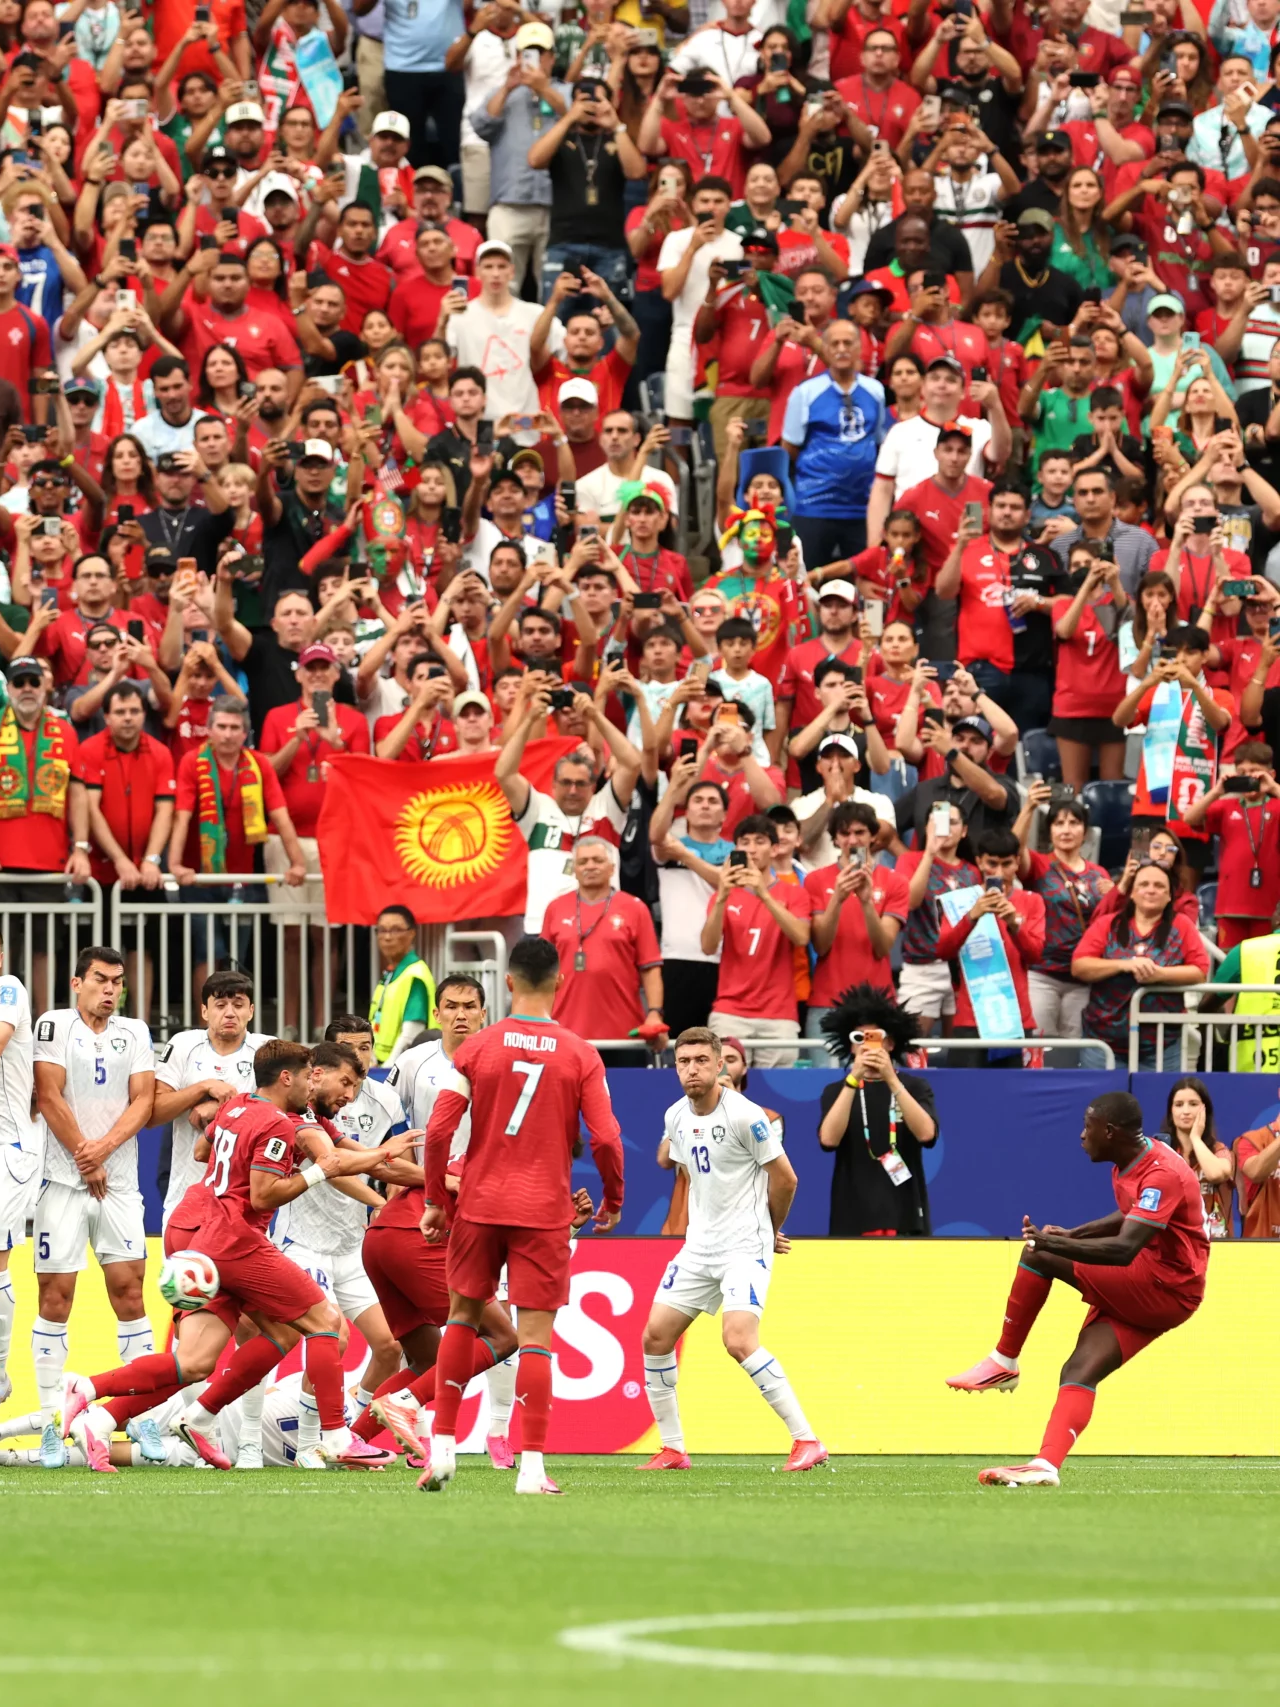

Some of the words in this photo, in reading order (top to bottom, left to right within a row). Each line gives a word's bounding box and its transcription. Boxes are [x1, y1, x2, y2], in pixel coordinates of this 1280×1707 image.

[748, 318, 760, 341] 7
[1083, 630, 1096, 656] 7
[747, 927, 761, 956] 7
[503, 1032, 557, 1053] RONALDO
[94, 1057, 107, 1085] 5
[505, 1060, 546, 1135] 7
[691, 1145, 710, 1174] 13
[38, 1232, 50, 1260] 5
